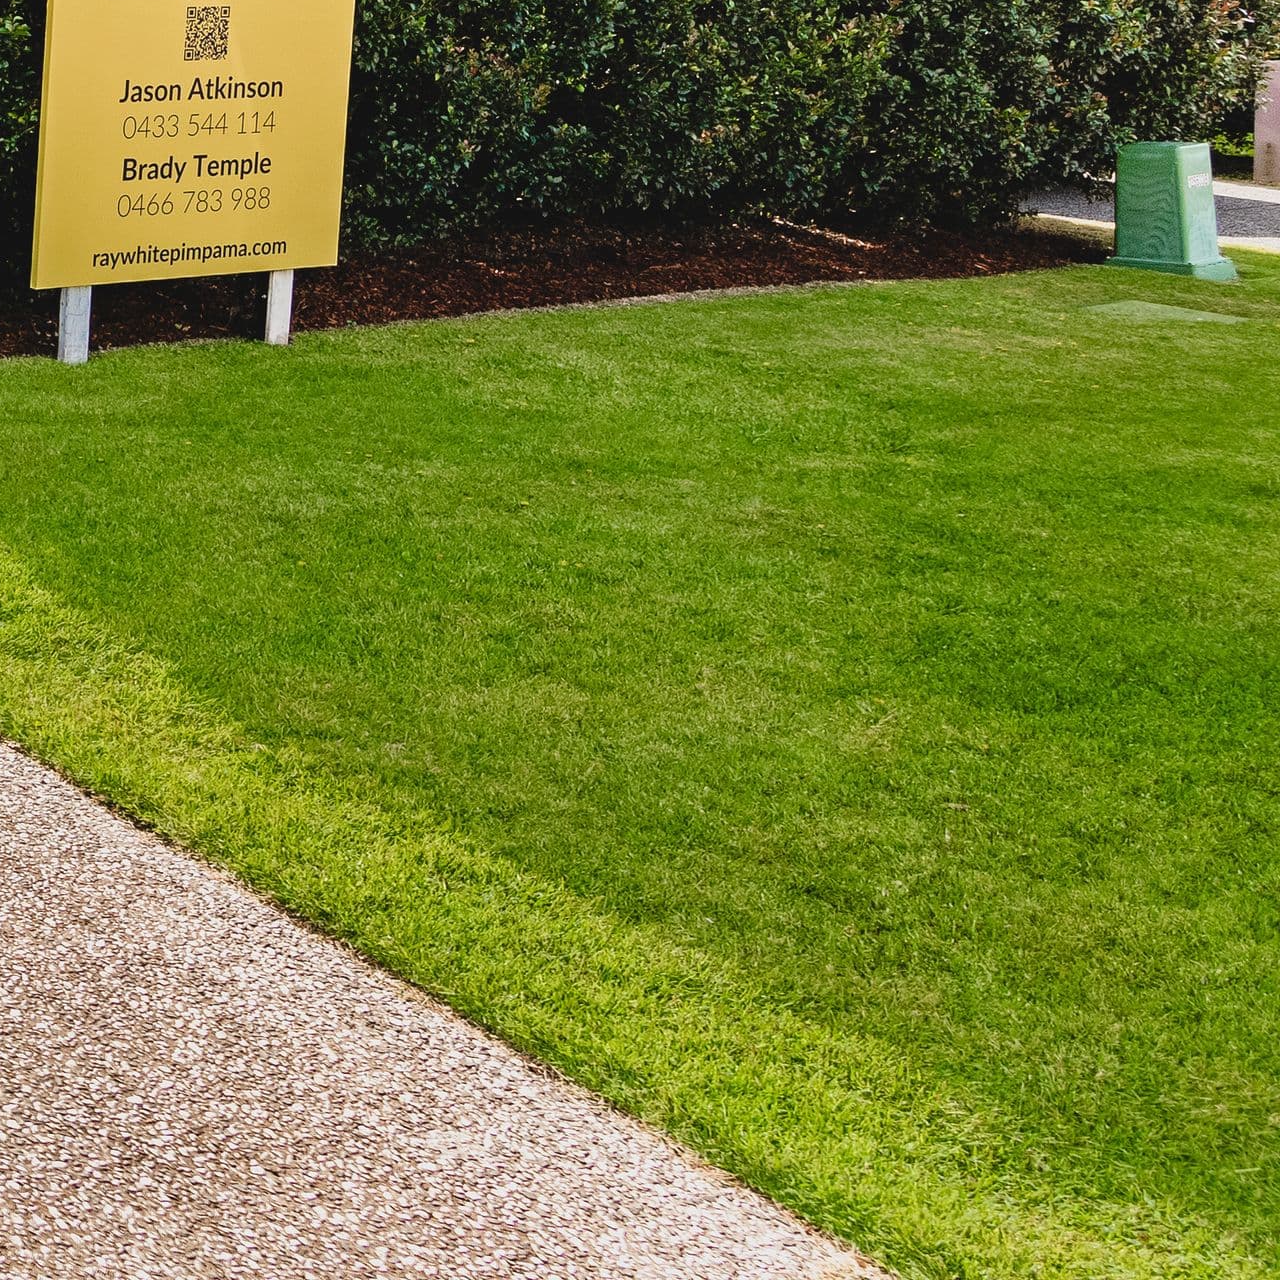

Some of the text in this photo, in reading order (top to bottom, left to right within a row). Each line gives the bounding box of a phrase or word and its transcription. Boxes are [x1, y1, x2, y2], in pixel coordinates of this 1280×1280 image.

[119, 76, 283, 103] Jason Atkinson
[122, 110, 276, 139] 0433 544 114
[121, 152, 272, 183] Brady Temple
[117, 186, 271, 218] 0466 783 988
[92, 239, 287, 270] raywhitepimpama.com
